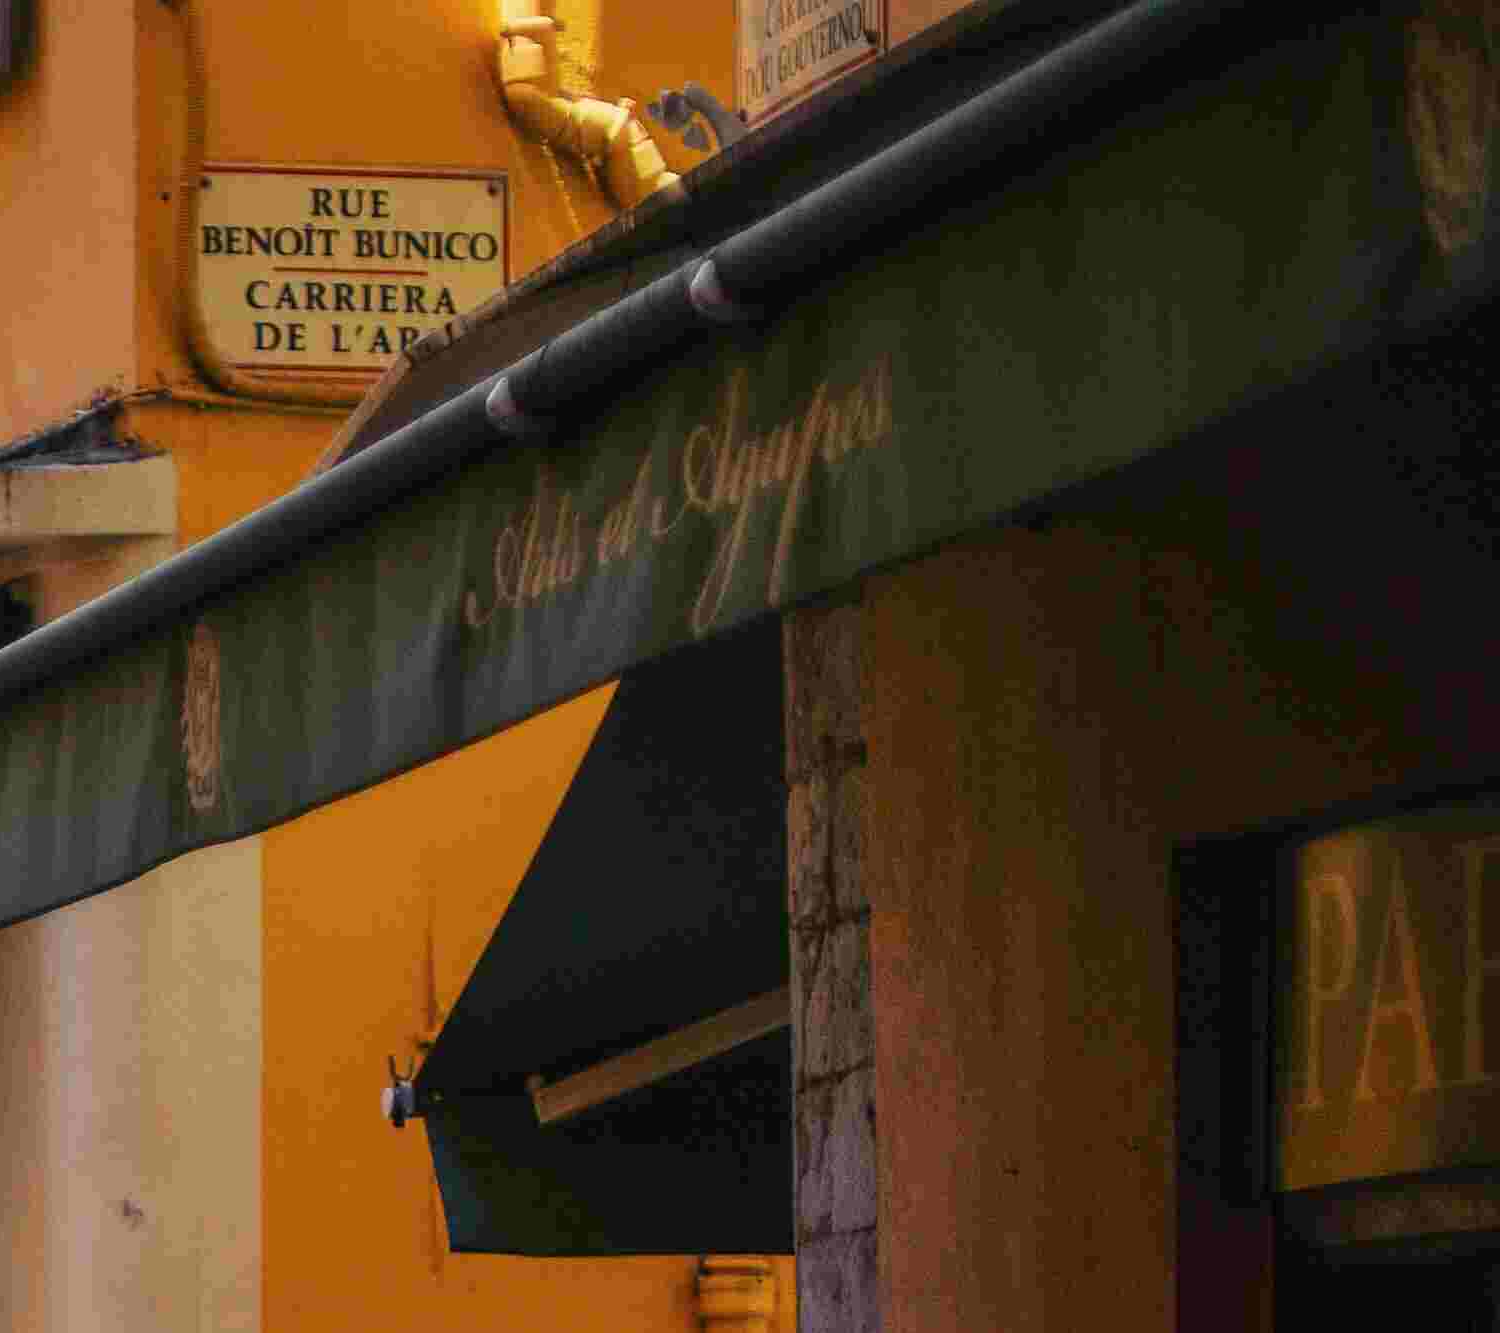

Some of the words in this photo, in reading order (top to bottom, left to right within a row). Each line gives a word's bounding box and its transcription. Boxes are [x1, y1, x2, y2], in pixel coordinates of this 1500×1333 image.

[311, 186, 390, 219] RUE
[202, 222, 340, 257] BENOÎT
[354, 230, 498, 261] BUNICO
[245, 280, 457, 314] CARRIERA
[255, 321, 307, 352] DE
